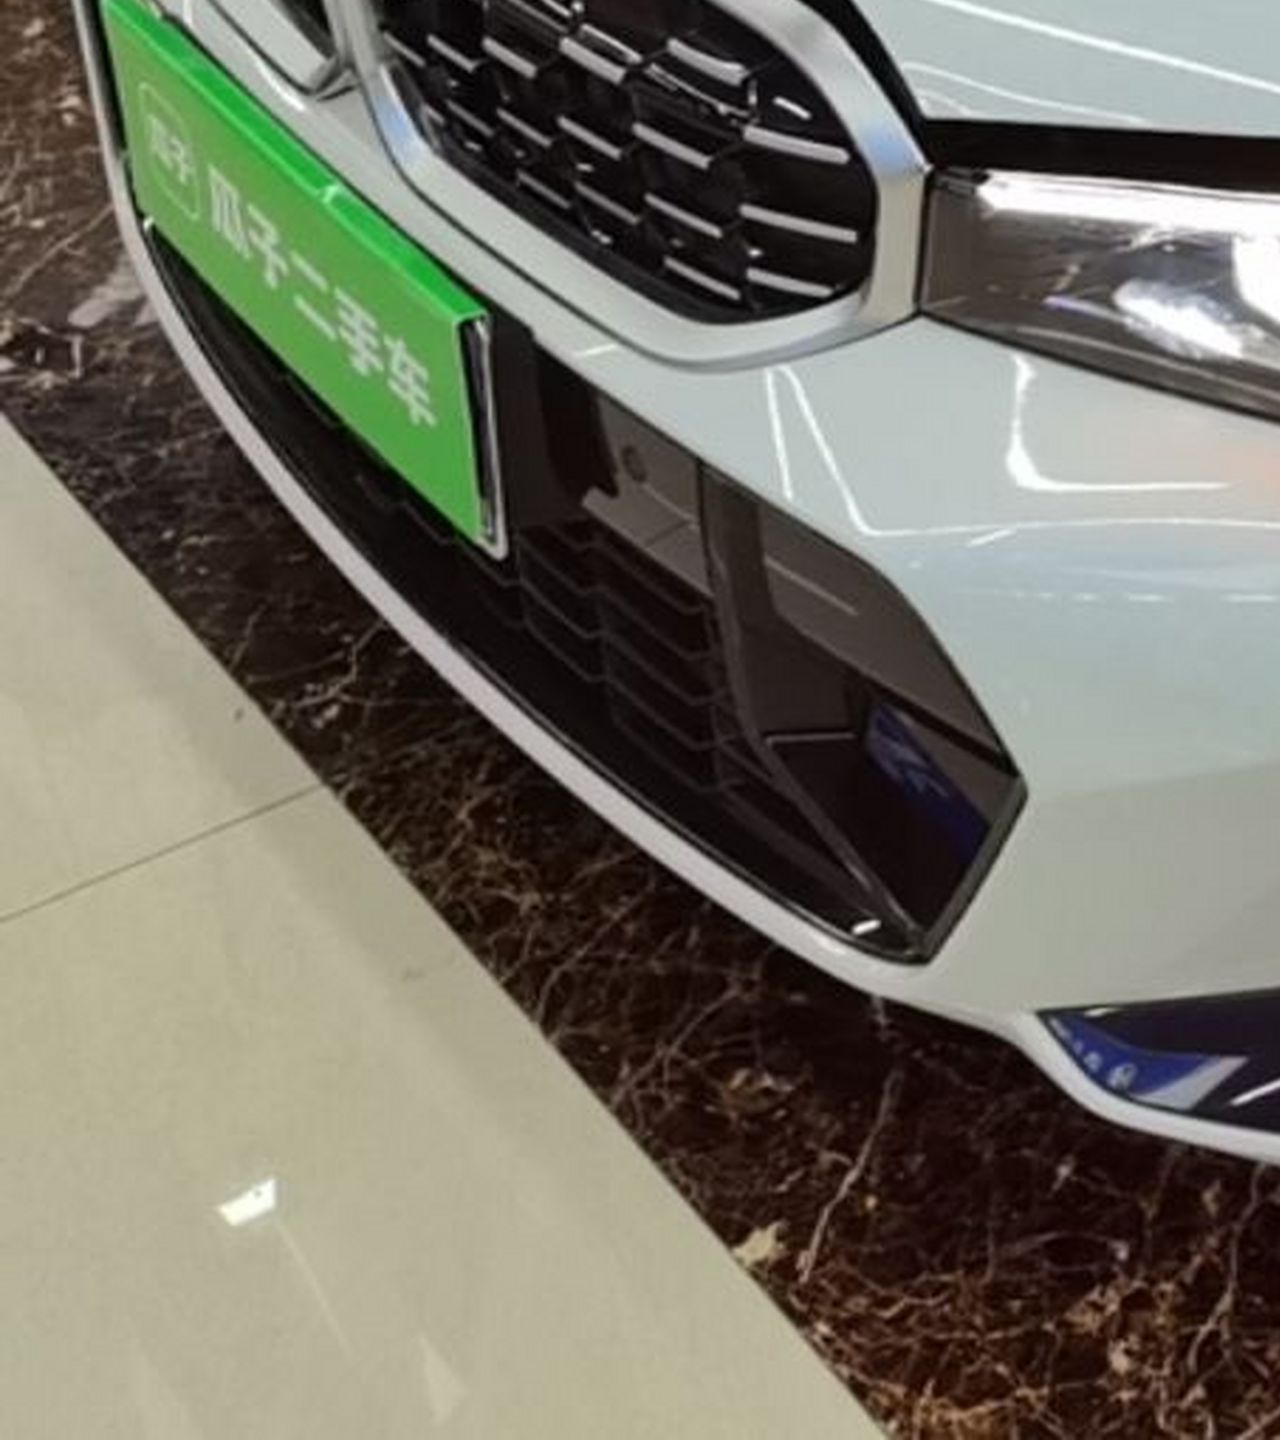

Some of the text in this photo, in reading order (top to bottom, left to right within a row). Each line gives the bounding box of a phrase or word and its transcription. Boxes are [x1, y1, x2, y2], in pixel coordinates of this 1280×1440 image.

[207, 162, 438, 428] 瓜子二手车
